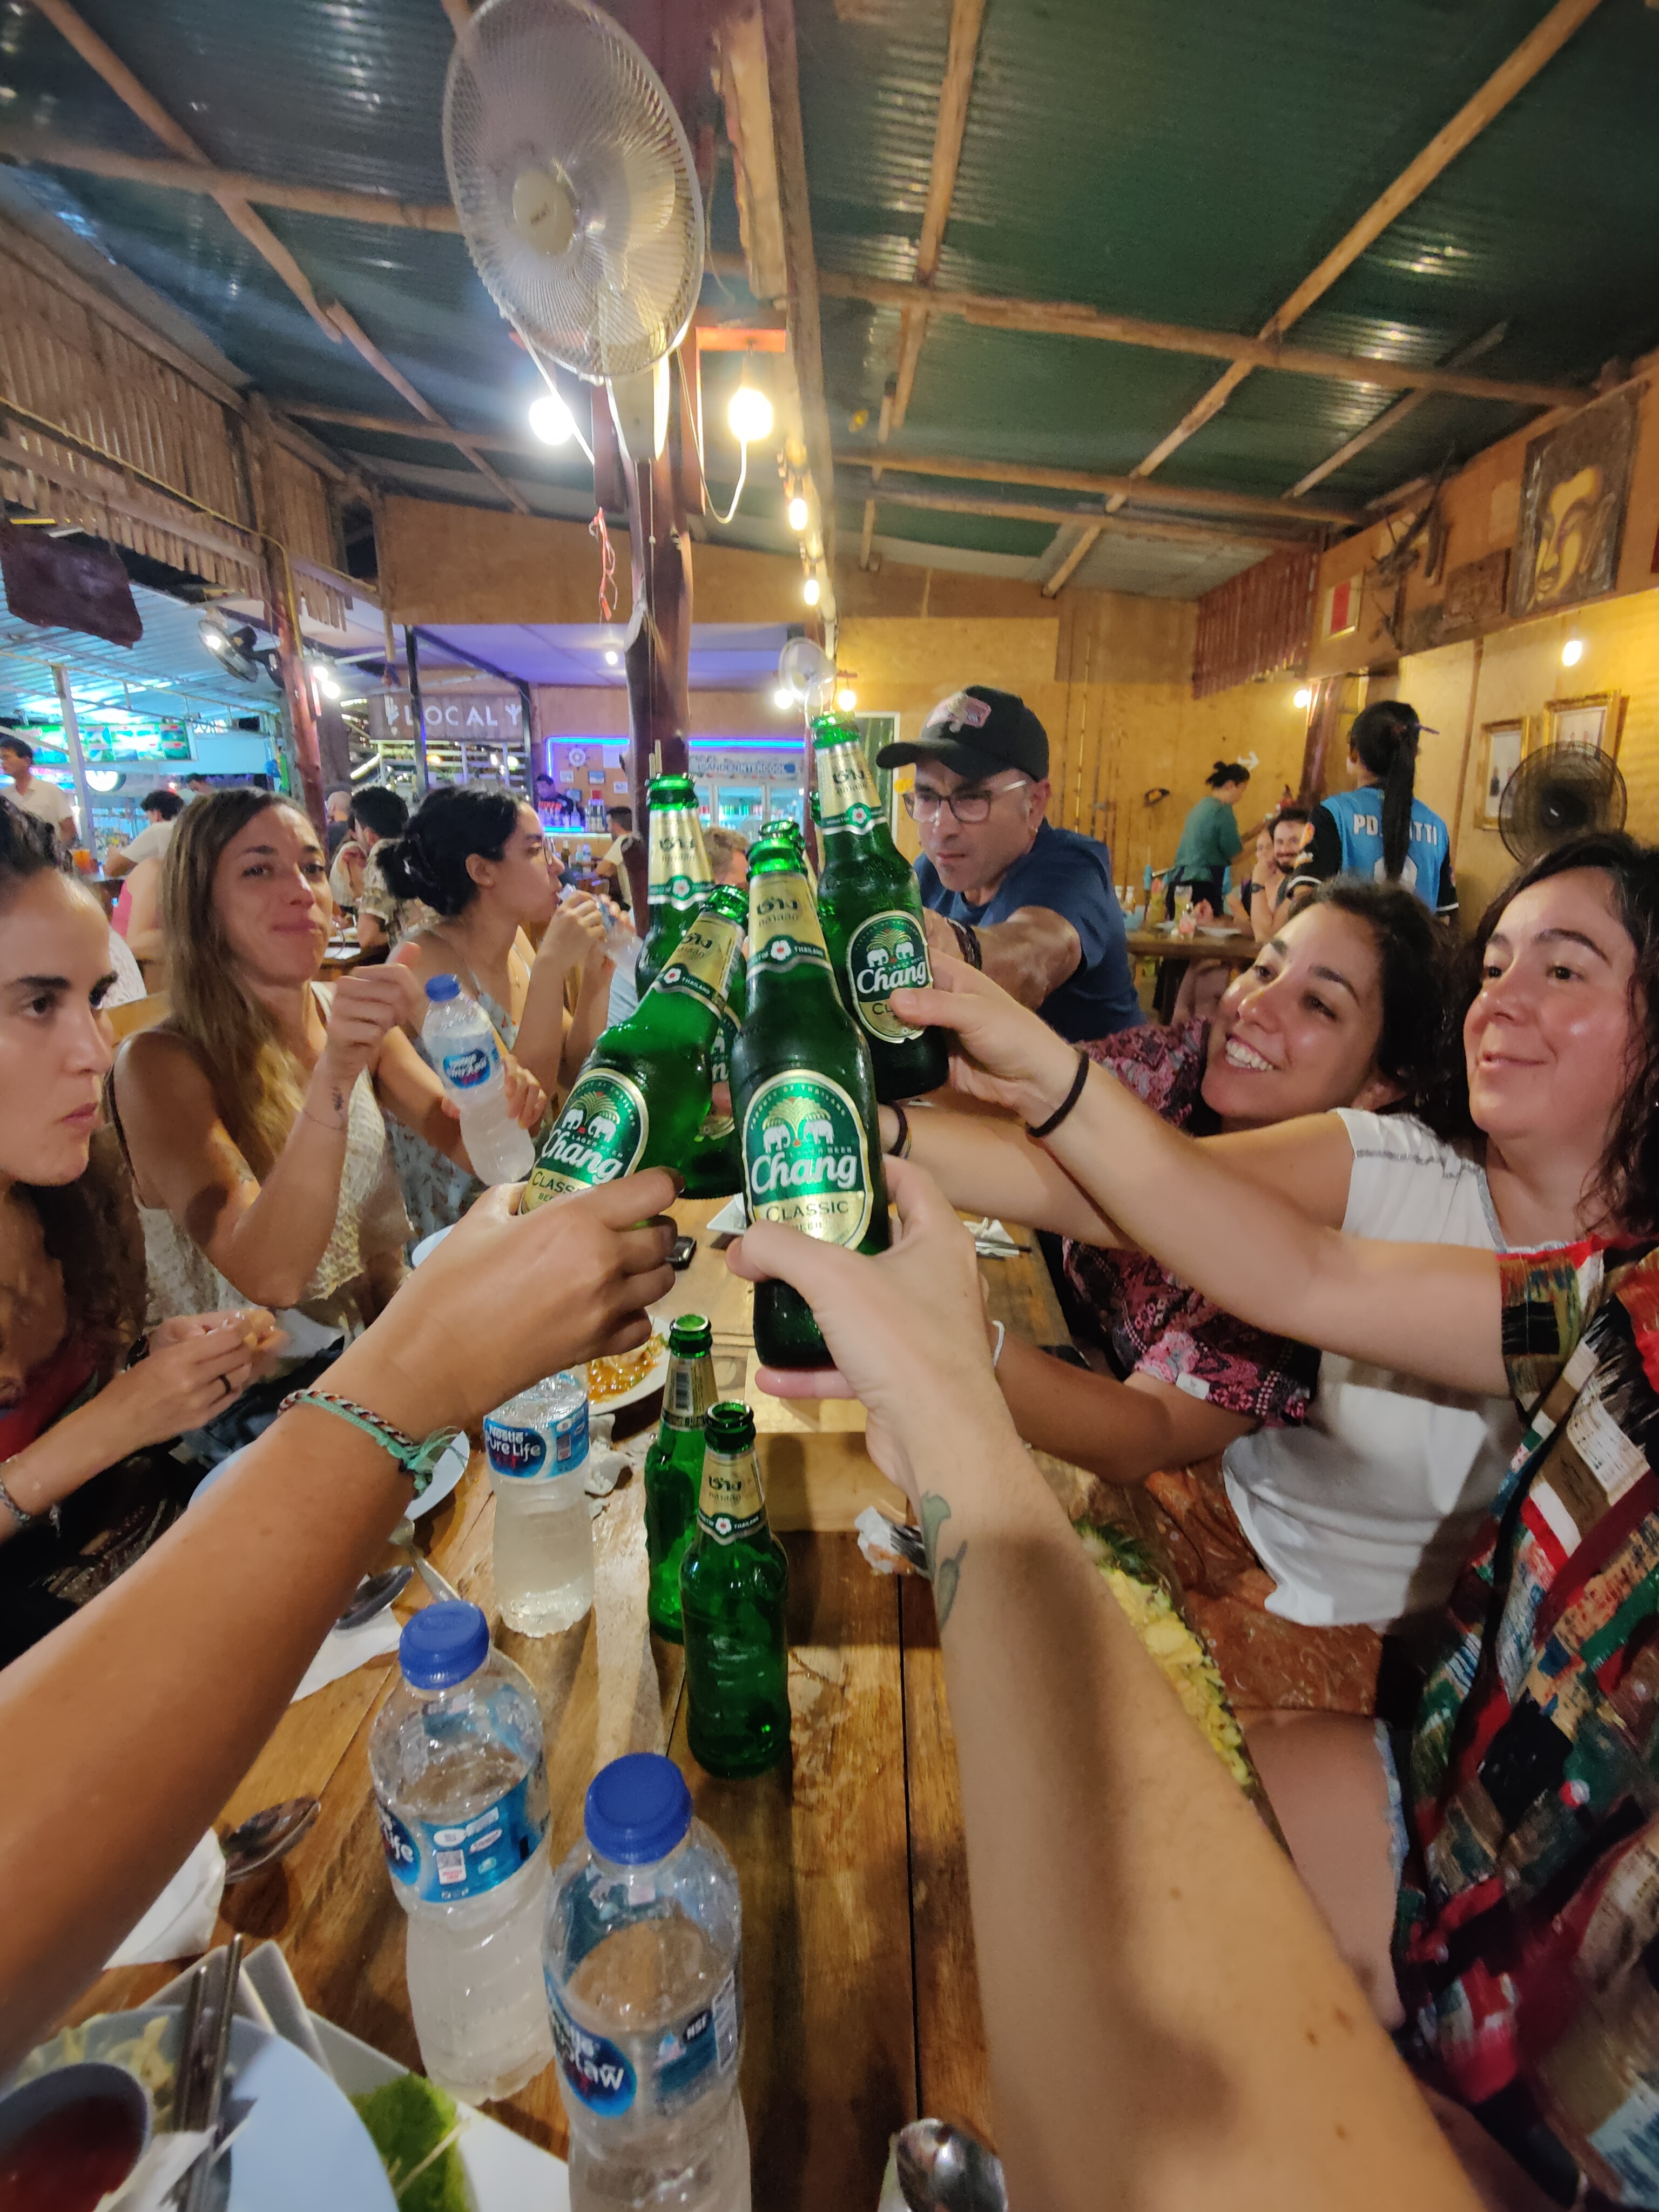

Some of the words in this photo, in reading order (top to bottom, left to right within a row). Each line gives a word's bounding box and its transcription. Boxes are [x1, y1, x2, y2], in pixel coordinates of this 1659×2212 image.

[404, 705, 498, 726] LOCAL
[682, 976, 711, 995] THAILAND
[857, 961, 927, 994] Chang
[542, 1128, 623, 1185] Chang
[751, 1151, 858, 1195] Chang
[766, 1200, 849, 1223] CLASSIC
[513, 1441, 541, 1462] Life
